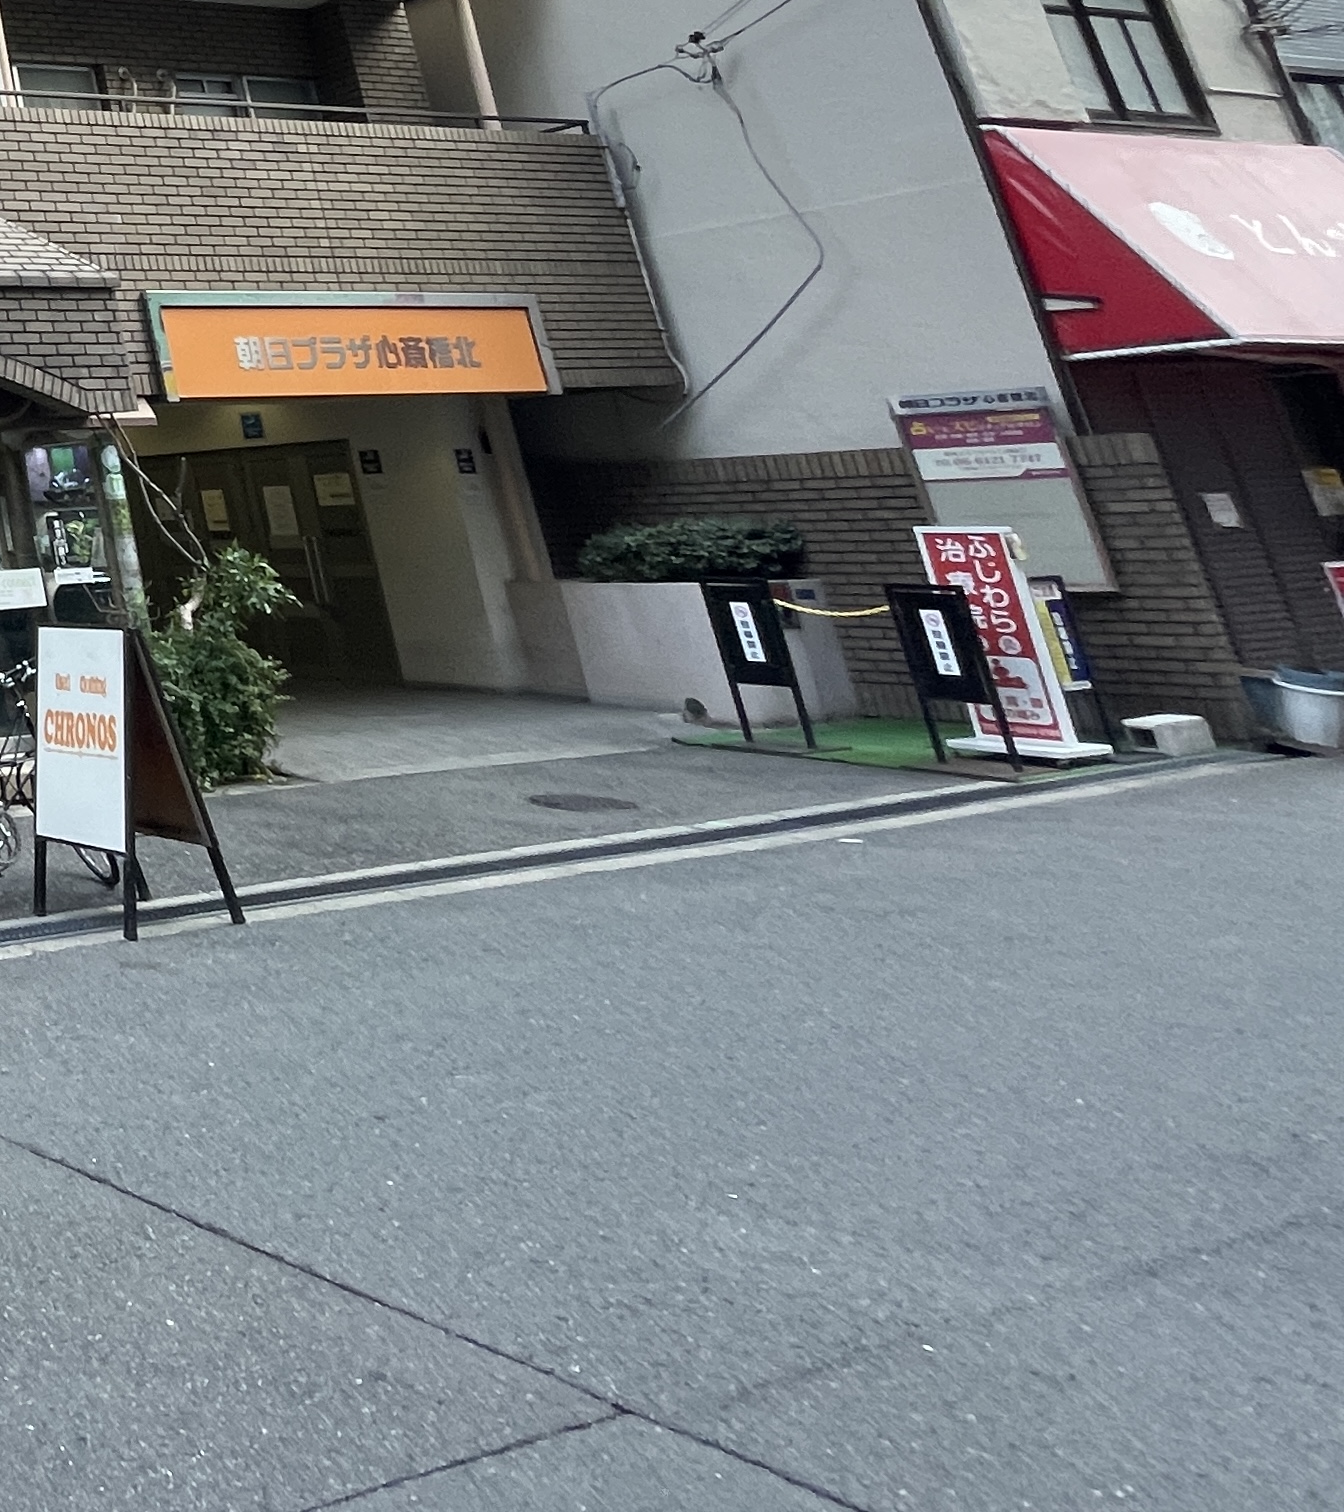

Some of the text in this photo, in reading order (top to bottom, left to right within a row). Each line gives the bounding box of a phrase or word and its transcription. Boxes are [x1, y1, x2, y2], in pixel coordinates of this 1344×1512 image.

[233, 334, 482, 371] 朝日プラザ心斎橋北
[967, 534, 1018, 634] ふじわら
[43, 708, 118, 753] CHRONOS
